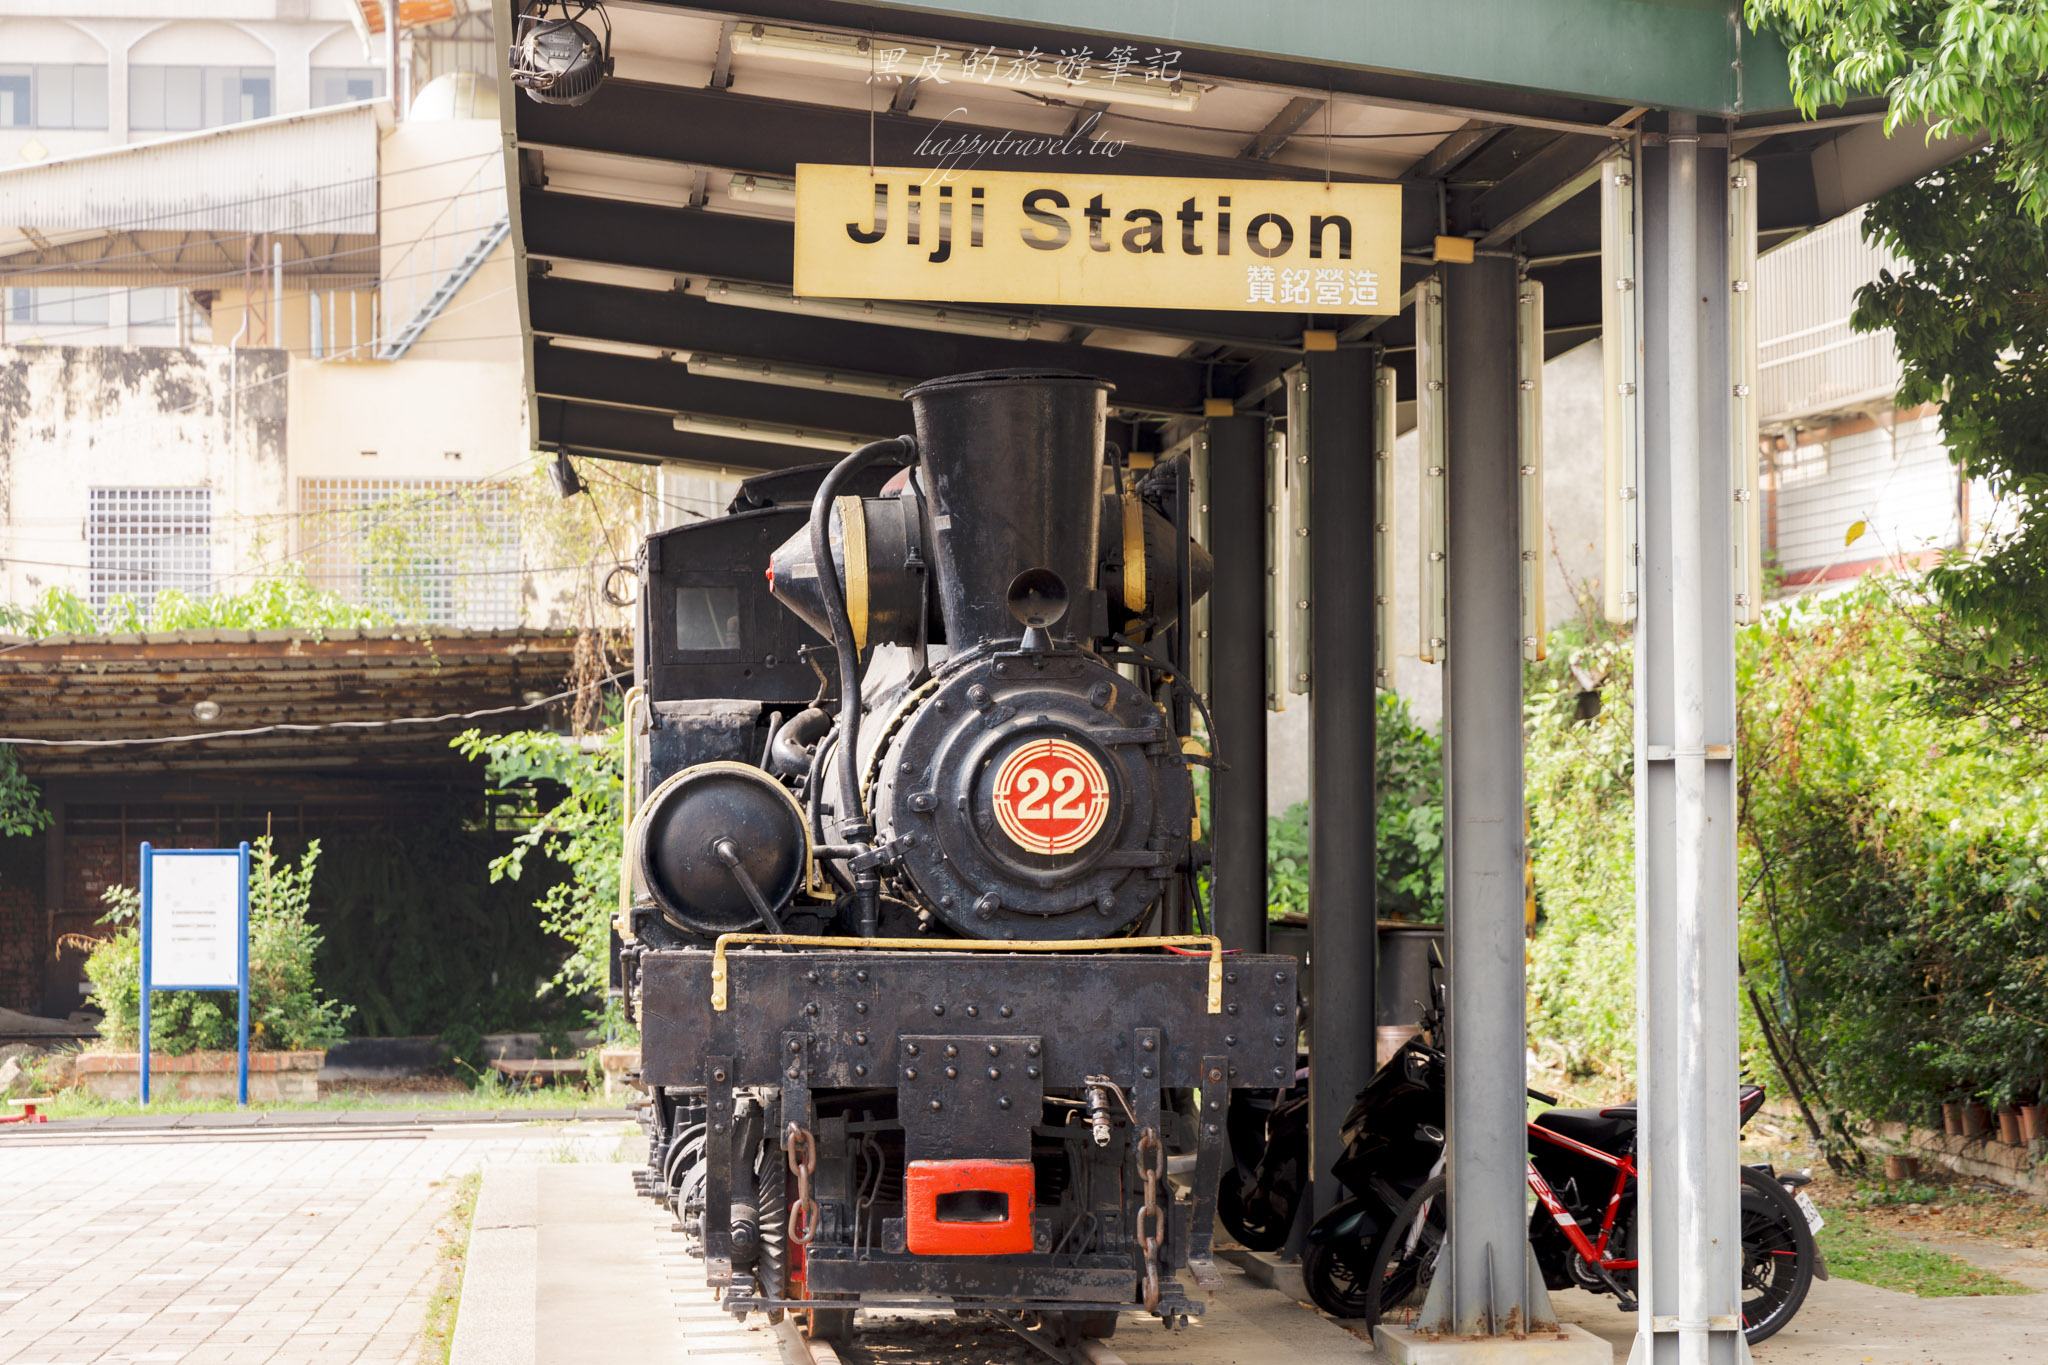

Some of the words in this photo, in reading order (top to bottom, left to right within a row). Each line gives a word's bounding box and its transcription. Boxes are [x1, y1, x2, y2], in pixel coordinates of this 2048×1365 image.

[846, 183, 985, 263] Jiji
[1020, 188, 1352, 259] Station
[1017, 767, 1086, 820] 22
